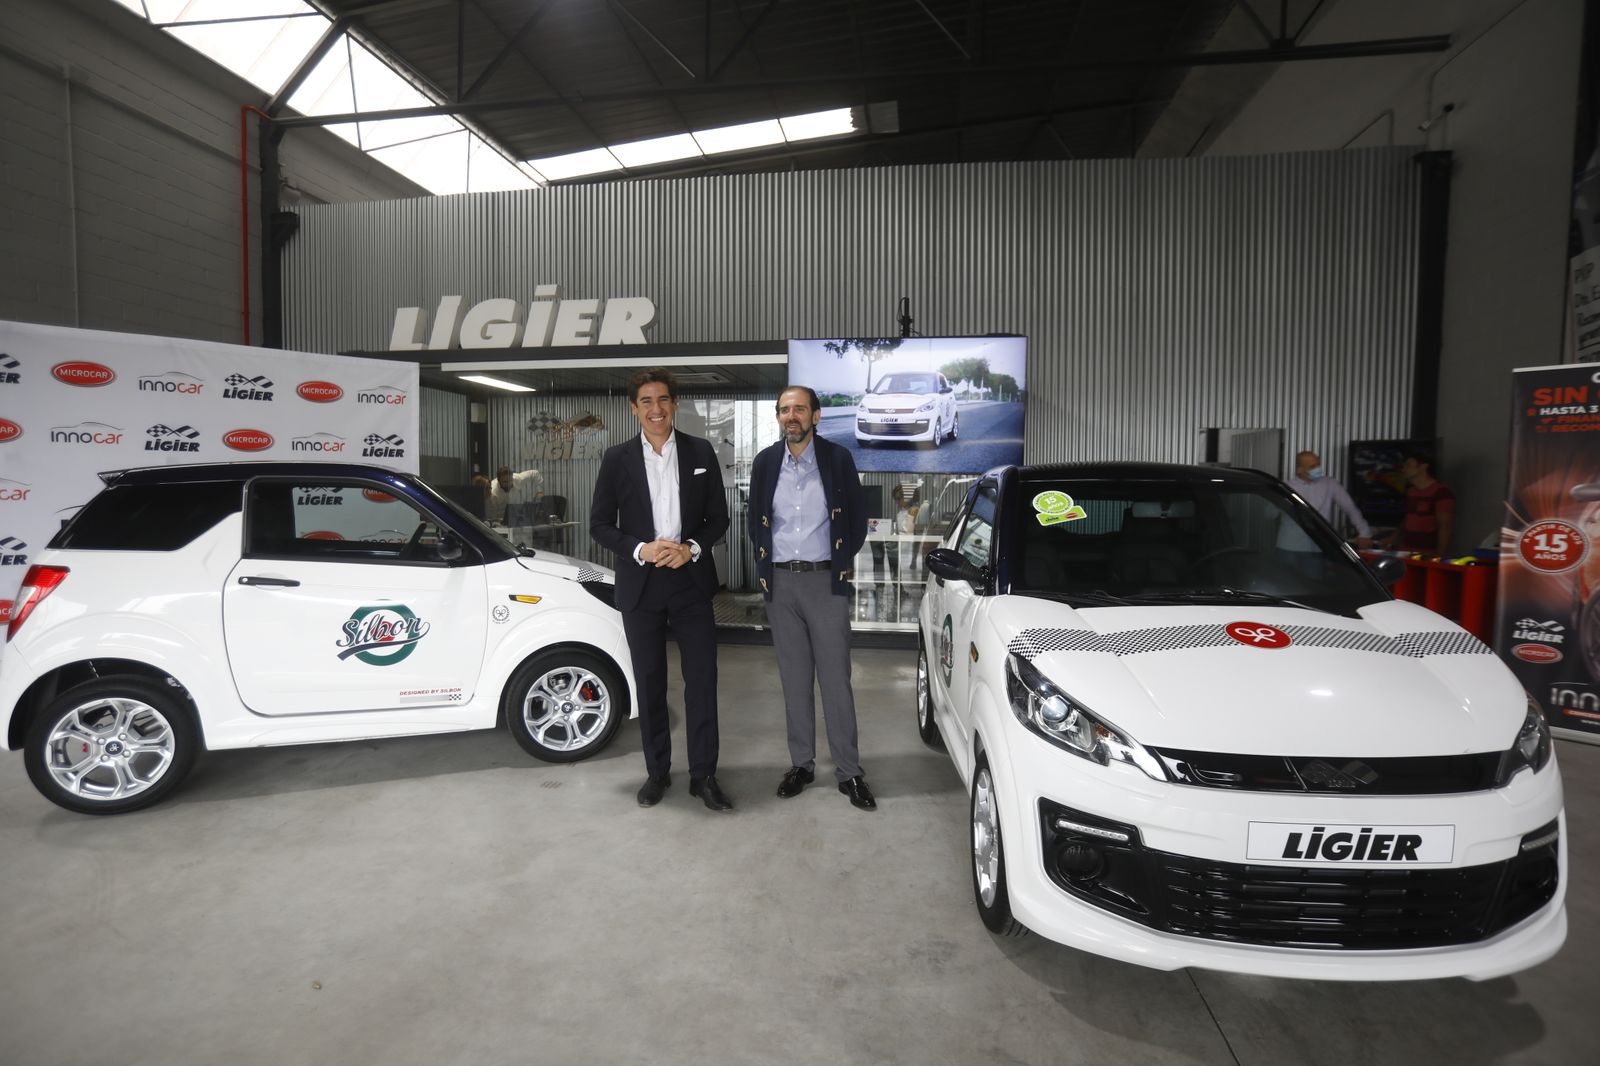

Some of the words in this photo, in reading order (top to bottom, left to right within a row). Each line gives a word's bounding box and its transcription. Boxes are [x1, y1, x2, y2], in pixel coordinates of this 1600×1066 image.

[60, 369, 108, 378] MICROCAR
[303, 387, 338, 395] MICROCAR
[1535, 387, 1588, 405] SIN
[1540, 406, 1585, 415] HASTA
[1534, 533, 1568, 553] 15
[335, 613, 430, 648] Silbon
